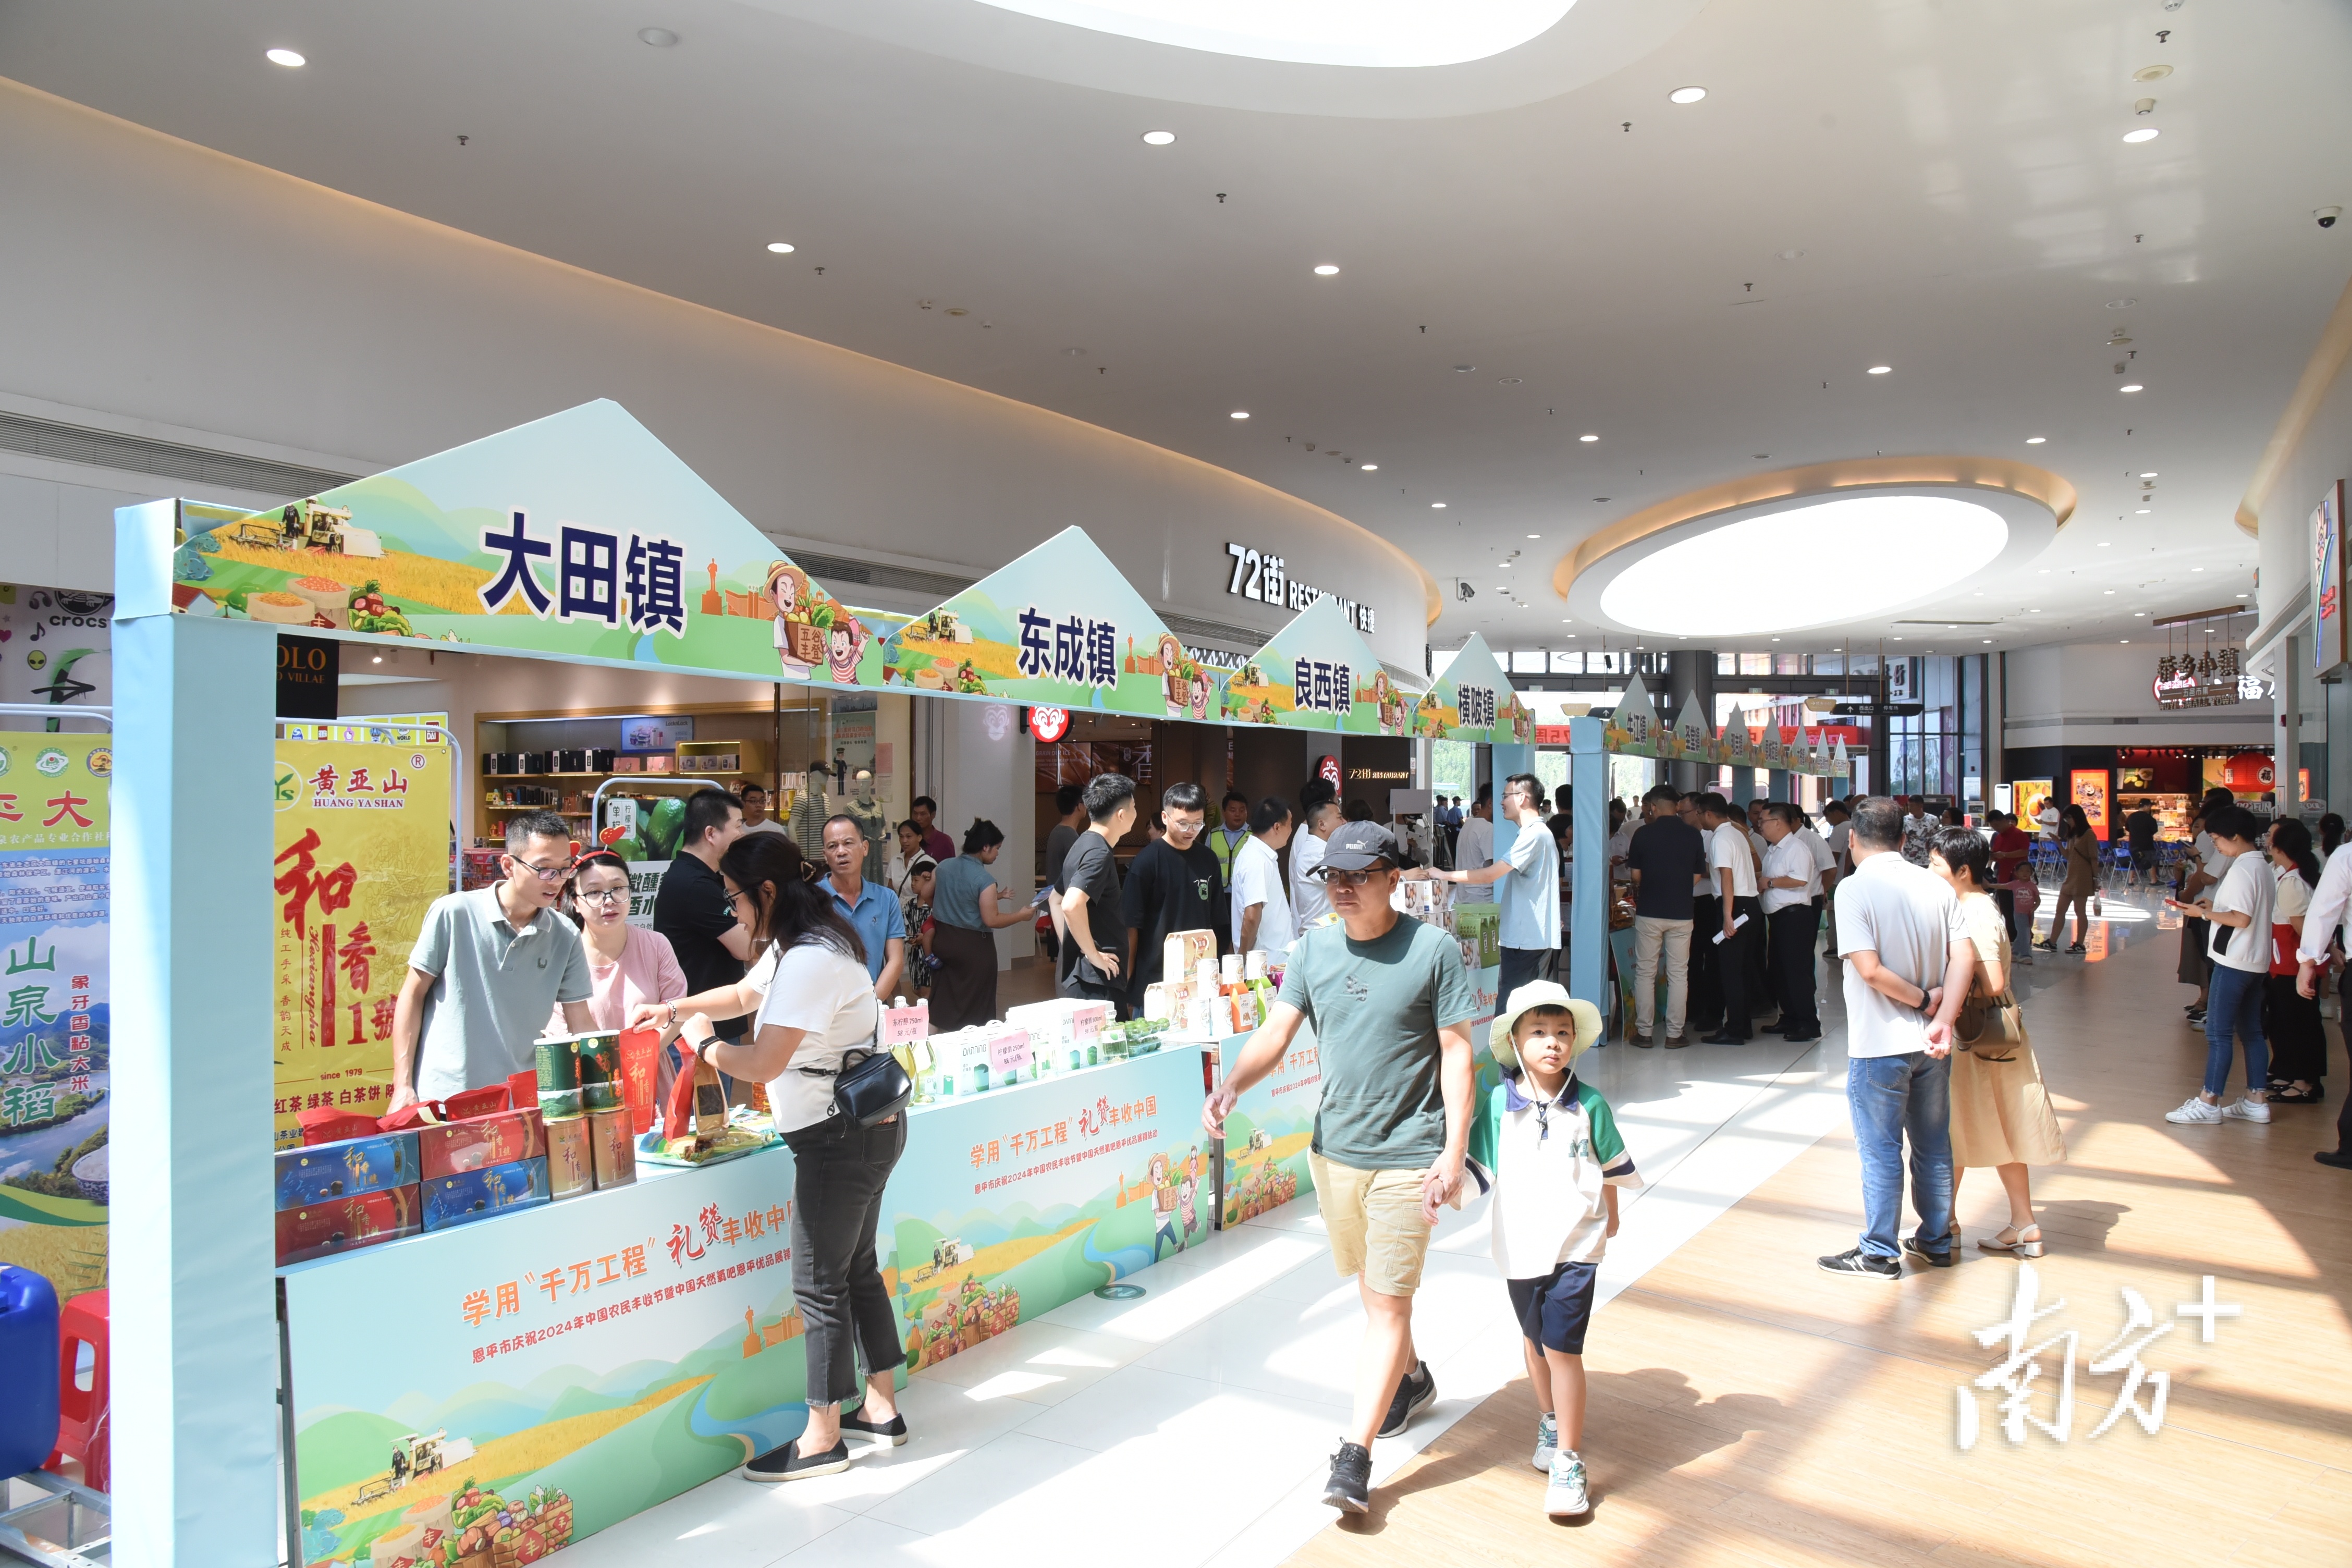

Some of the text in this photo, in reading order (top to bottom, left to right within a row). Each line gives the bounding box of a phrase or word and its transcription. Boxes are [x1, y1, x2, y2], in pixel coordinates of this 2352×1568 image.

[483, 511, 683, 633] 大田镇
[1227, 542, 1375, 633] 72街 RESTANT 快捷
[50, 615, 107, 628] crocs
[1019, 606, 1116, 687] 东成镇
[1295, 657, 1350, 714] 良西镇
[1458, 683, 1495, 728] 横陂镇
[309, 764, 408, 797] 黄亚山
[2261, 769, 2272, 781] 福
[313, 799, 404, 808] HUANG YA SHAN
[2252, 803, 2272, 813] FUN
[279, 928, 292, 1052] 纯工手采 香韵天成
[2, 935, 61, 1128] 山泉小稻
[70, 975, 90, 1093] 象牙香粘大米
[893, 1016, 923, 1027] 东柠醇 750ml
[1081, 1018, 1092, 1026] 柠檬酒
[998, 1042, 1025, 1056] 柠檬酒 250ml
[320, 1068, 363, 1081] since 1979
[274, 1095, 302, 1114] 红茶
[307, 1091, 334, 1109] 绿茶
[340, 1084, 381, 1105] 白茶饼
[1078, 1094, 1157, 1140] 礼赞丰收中国
[666, 1201, 791, 1268] 礼赞丰收中
